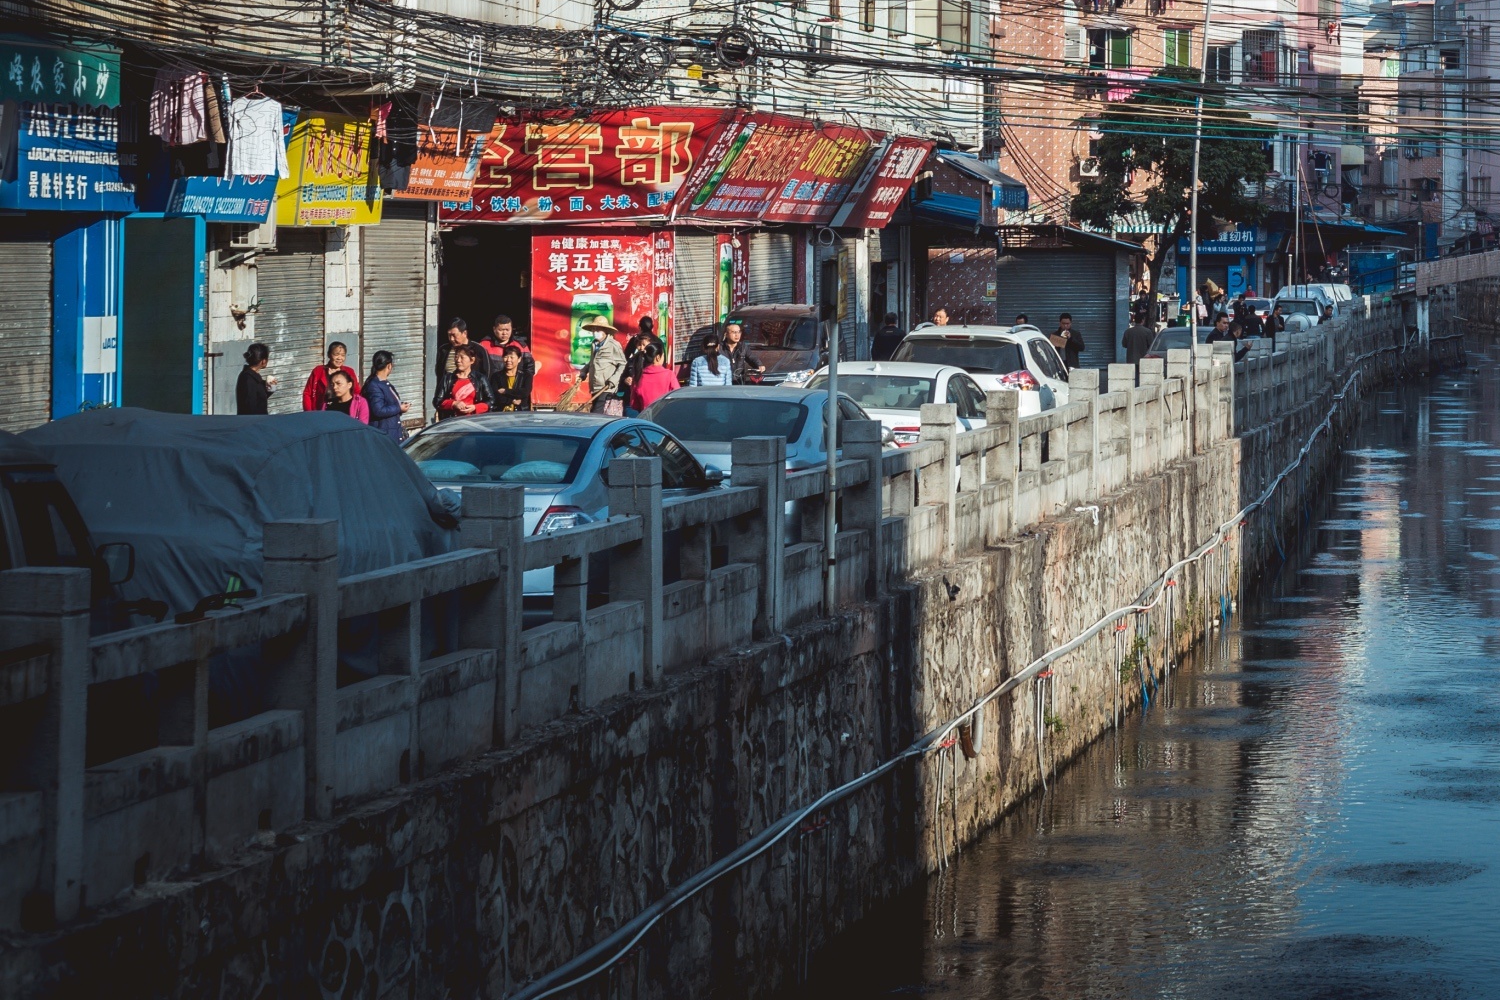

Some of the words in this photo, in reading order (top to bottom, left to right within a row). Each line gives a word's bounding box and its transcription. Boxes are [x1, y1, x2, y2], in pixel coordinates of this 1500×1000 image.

[548, 252, 639, 274] 第五道菜
[555, 275, 630, 292] 天地壹号
